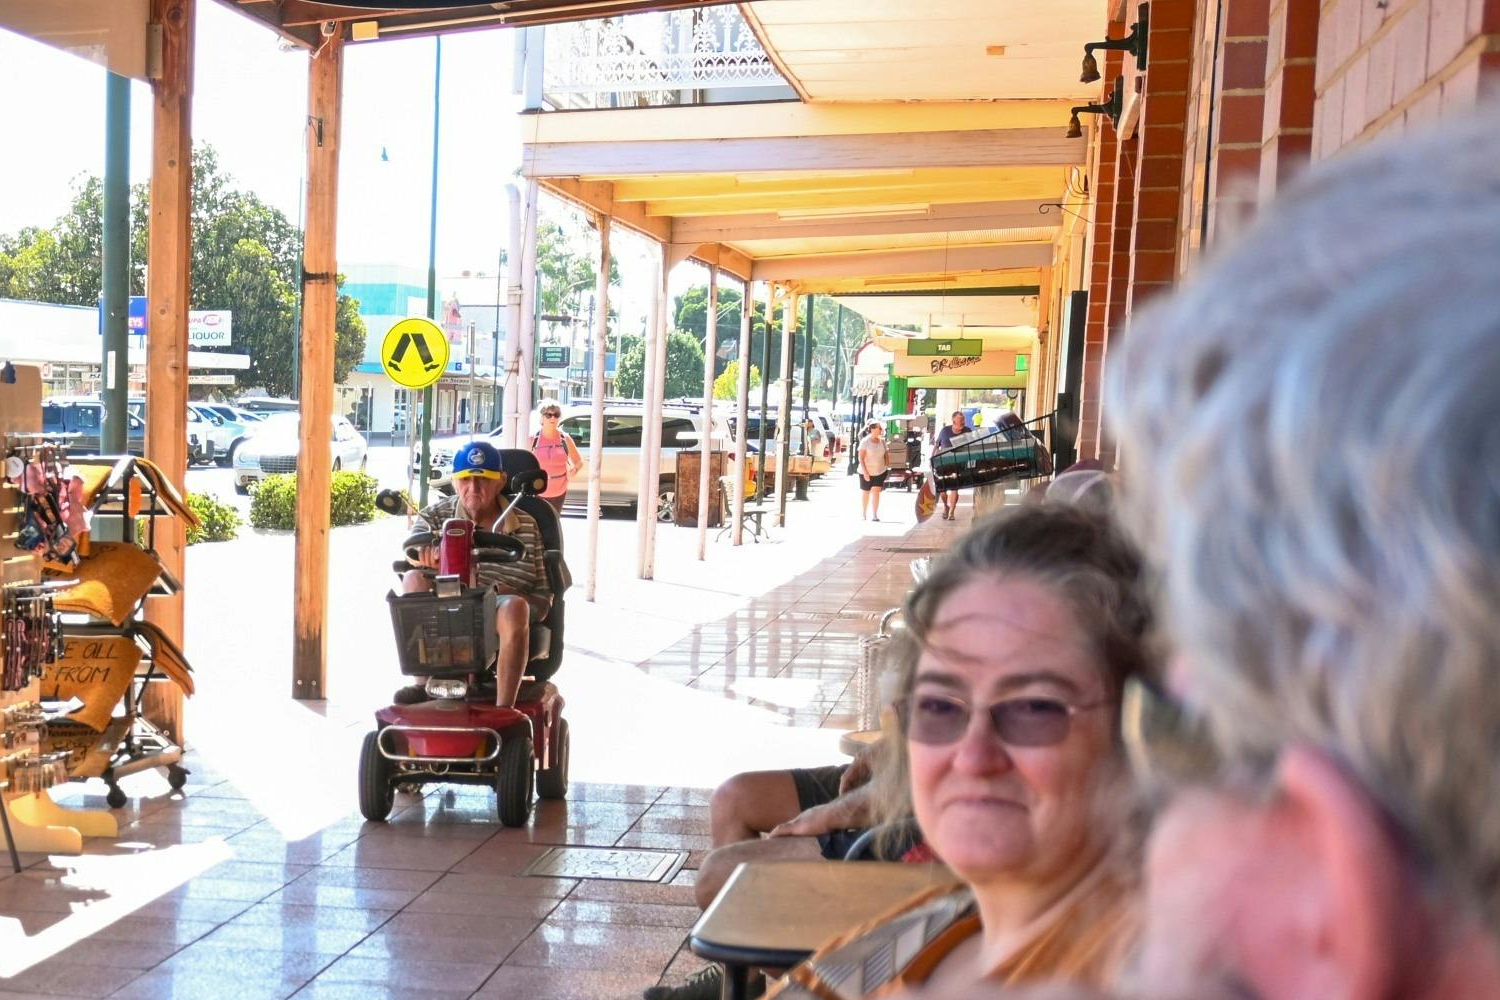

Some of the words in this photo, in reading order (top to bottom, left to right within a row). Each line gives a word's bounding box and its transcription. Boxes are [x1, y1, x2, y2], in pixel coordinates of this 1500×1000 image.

[128, 317, 143, 328] EYS
[188, 331, 225, 340] IQUOR
[55, 665, 111, 683] FROM
